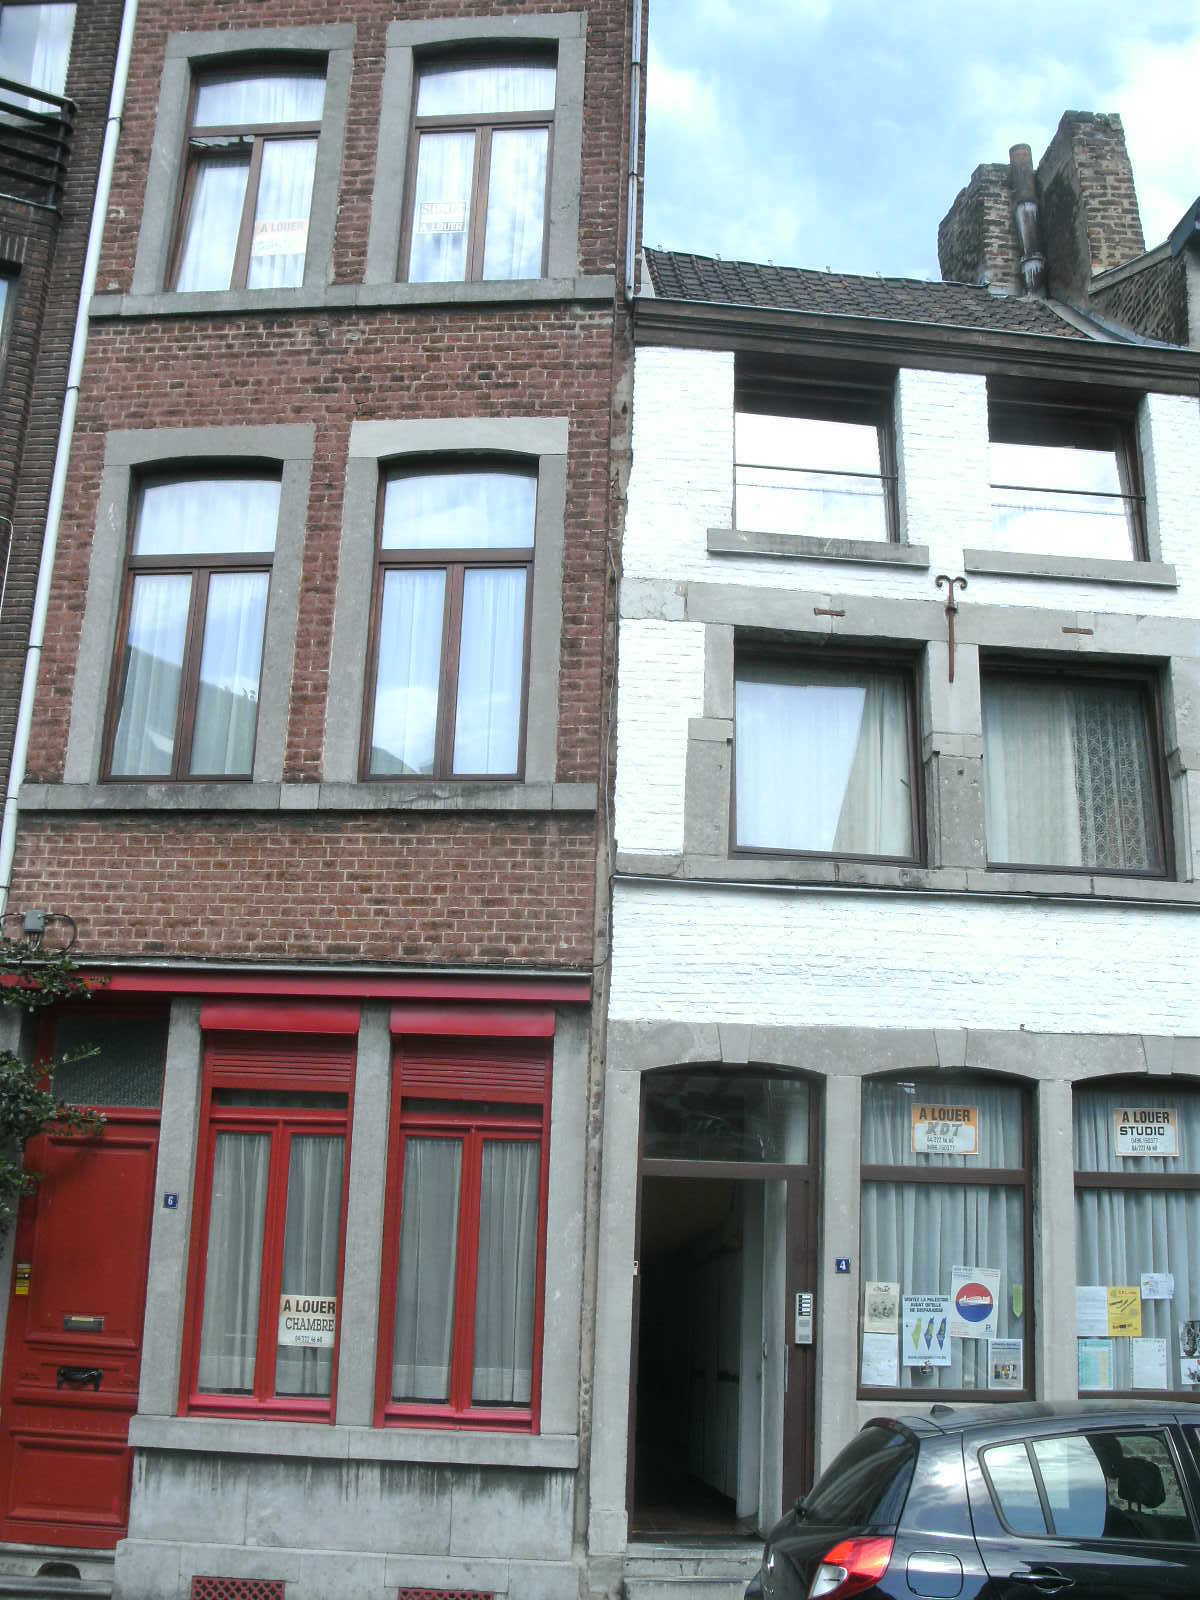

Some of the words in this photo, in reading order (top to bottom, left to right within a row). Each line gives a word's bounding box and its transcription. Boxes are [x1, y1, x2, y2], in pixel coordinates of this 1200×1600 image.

[271, 221, 306, 233] LOUER
[920, 1107, 928, 1120] A
[931, 1107, 971, 1122] LOUER
[1122, 1111, 1130, 1123] A
[1133, 1111, 1170, 1124] LOUER
[1119, 1126, 1165, 1136] STUDIO
[167, 1195, 174, 1206] 6
[839, 1259, 847, 1270] 4
[283, 1299, 291, 1312] A
[295, 1300, 336, 1314] LOUER
[285, 1317, 336, 1332] CHAMBRE
